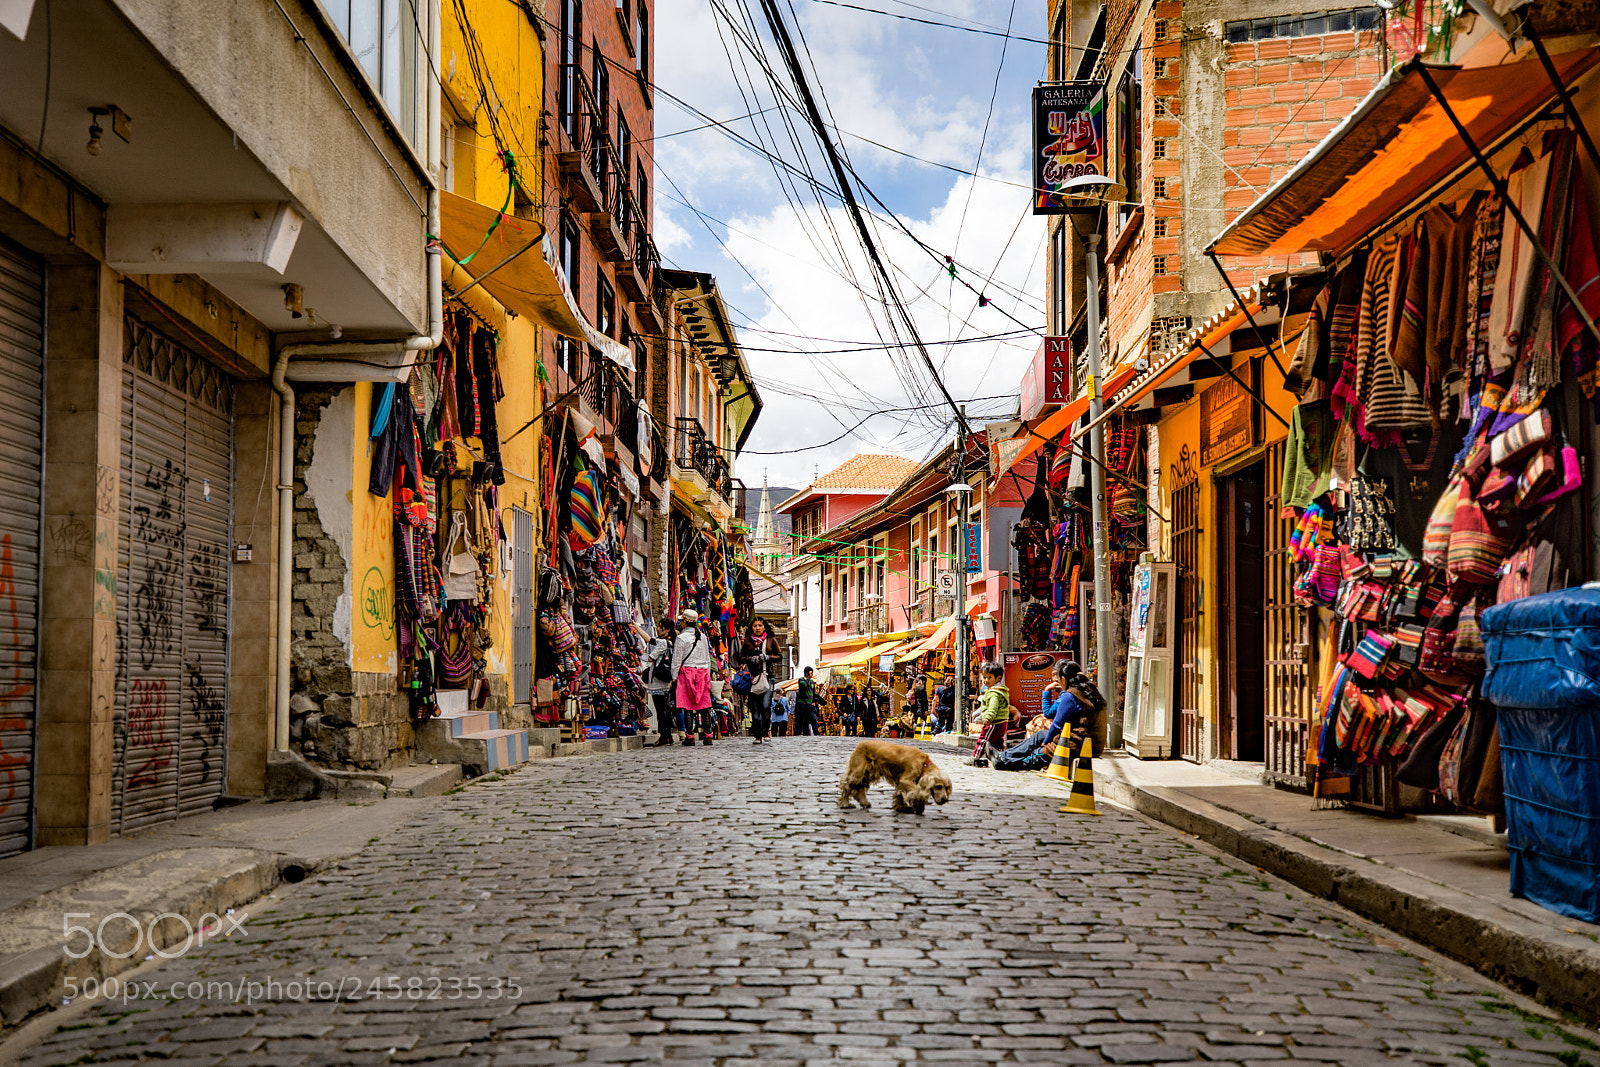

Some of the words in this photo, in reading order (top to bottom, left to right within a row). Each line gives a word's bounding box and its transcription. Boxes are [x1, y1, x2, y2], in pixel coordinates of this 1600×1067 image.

[1042, 98, 1090, 106] ARTESANAL
[1044, 89, 1093, 99] GALERIA
[1050, 340, 1066, 399] MANÁ
[967, 523, 979, 567] PISCINA
